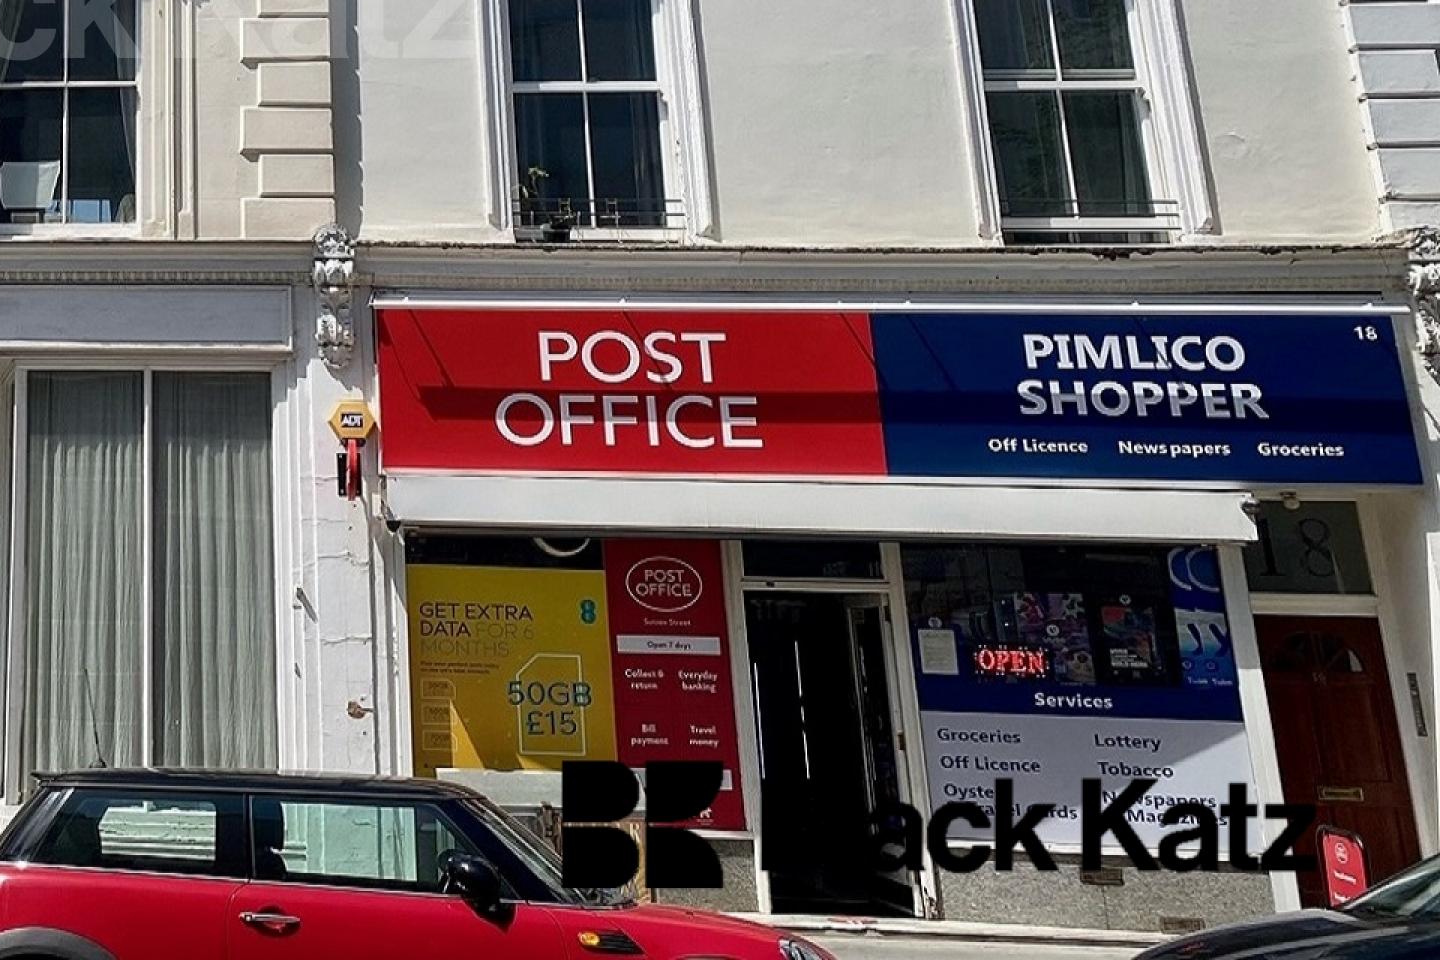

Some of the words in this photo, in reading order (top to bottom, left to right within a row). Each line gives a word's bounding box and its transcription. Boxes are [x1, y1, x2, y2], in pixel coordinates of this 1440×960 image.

[1353, 325, 1379, 342] 18
[538, 331, 727, 384] POST
[1022, 334, 1246, 373] PIMLICO
[1016, 379, 1270, 419] SHOPPER
[495, 392, 764, 449] OFFICE
[988, 438, 1018, 453] Off
[1022, 439, 1089, 454] Licence
[1117, 440, 1232, 459] Newspapers
[1257, 442, 1345, 458] Groceries
[644, 569, 685, 583] POST
[635, 582, 692, 598] OFFICE
[419, 602, 461, 619] GET
[464, 603, 533, 622] EXTRA
[420, 620, 472, 638] DATA
[475, 623, 517, 639] FOR
[523, 624, 535, 640] 6
[420, 640, 511, 658] MONTHS
[647, 640, 667, 649] Open
[978, 648, 1046, 673] OPEN
[624, 668, 656, 679] Collect
[678, 670, 718, 683] Everyday
[507, 680, 592, 708] 50GB
[631, 682, 658, 690] return
[681, 682, 717, 695] banking
[1034, 692, 1113, 709] Services
[526, 710, 577, 736] £15
[689, 724, 717, 735] Travel
[689, 739, 719, 749] money
[936, 727, 1022, 745] Groceries
[1093, 733, 1162, 753] Lottery
[939, 755, 970, 771] Off
[973, 756, 1042, 774] Licence
[1097, 761, 1175, 779] Tobacco
[943, 783, 997, 801] Oyste
[1102, 790, 1217, 811] Nspaers
